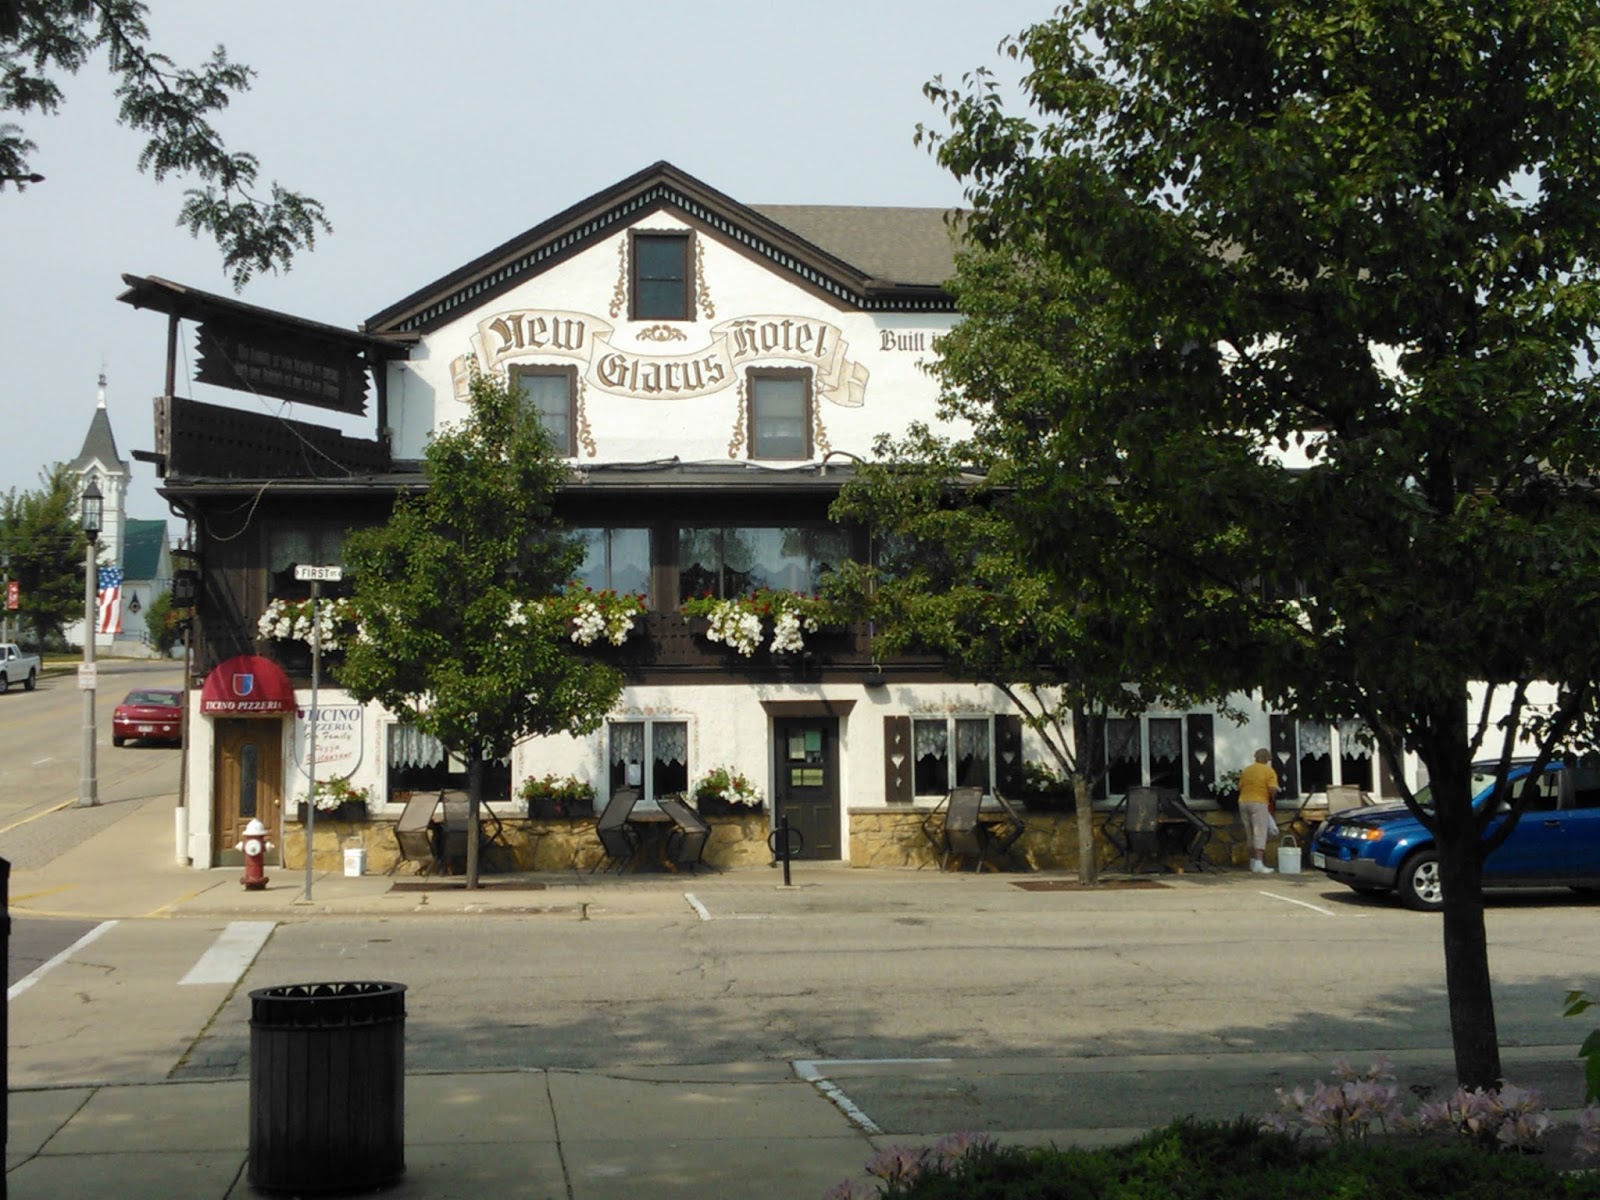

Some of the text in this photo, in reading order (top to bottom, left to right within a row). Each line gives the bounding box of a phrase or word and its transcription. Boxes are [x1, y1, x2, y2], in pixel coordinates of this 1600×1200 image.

[879, 329, 925, 351] Built
[488, 313, 828, 394] New Glarus Hotel
[302, 568, 330, 578] FIRST
[205, 701, 236, 710] TICINO
[304, 723, 353, 731] PZZERIA
